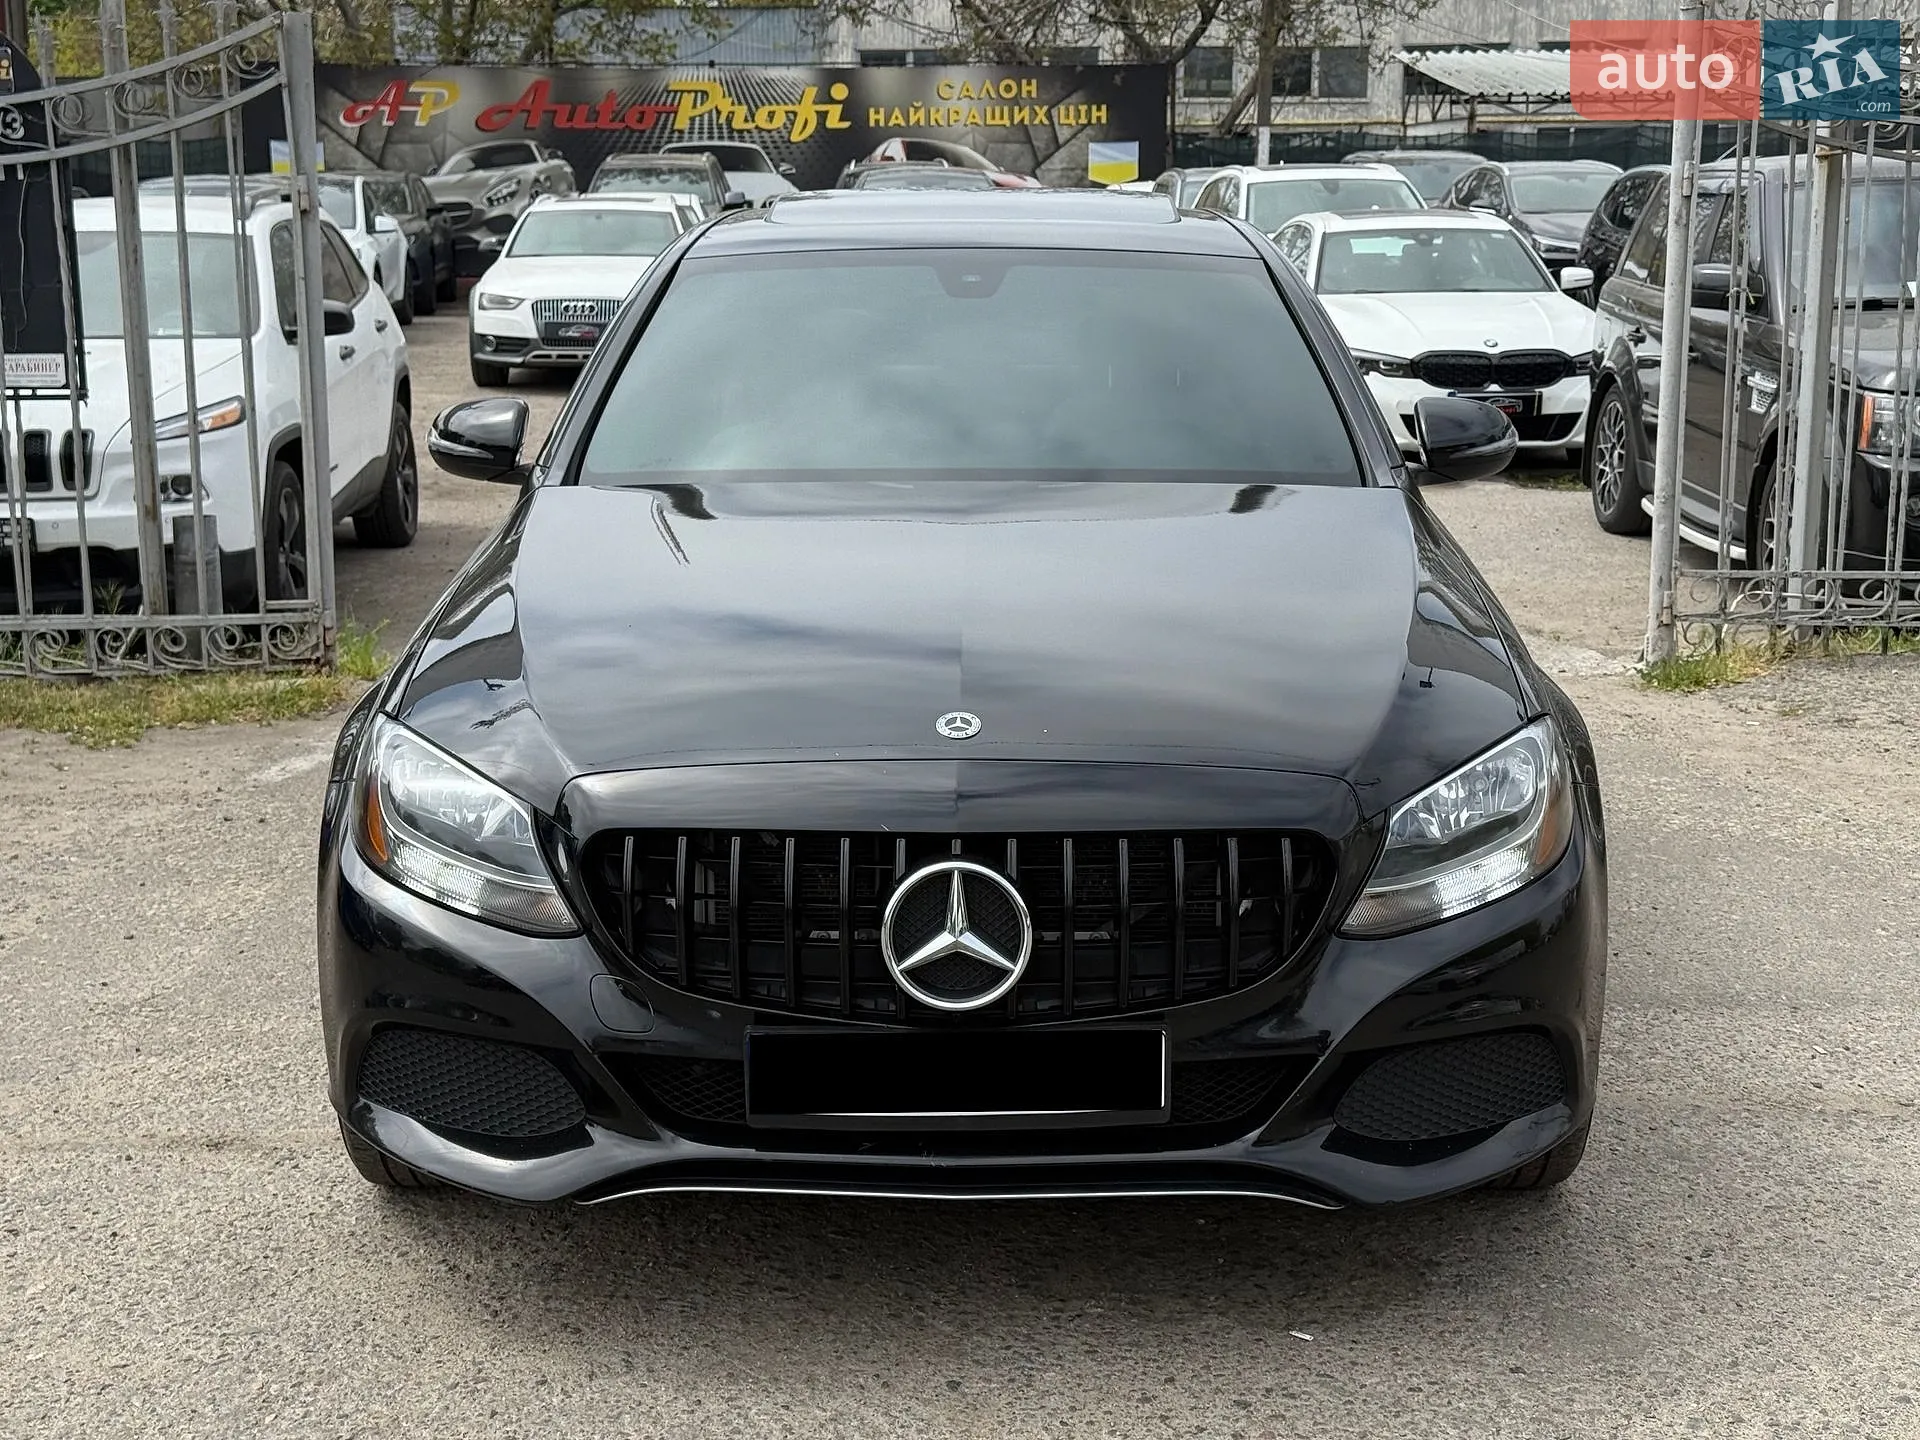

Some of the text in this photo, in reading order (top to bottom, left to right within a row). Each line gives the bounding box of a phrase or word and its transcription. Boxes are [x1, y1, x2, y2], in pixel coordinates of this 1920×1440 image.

[937, 79, 1039, 100] САЛОН
[340, 79, 461, 127] AP
[868, 102, 1109, 127] НАЙКРАЩИХ ЦІН
